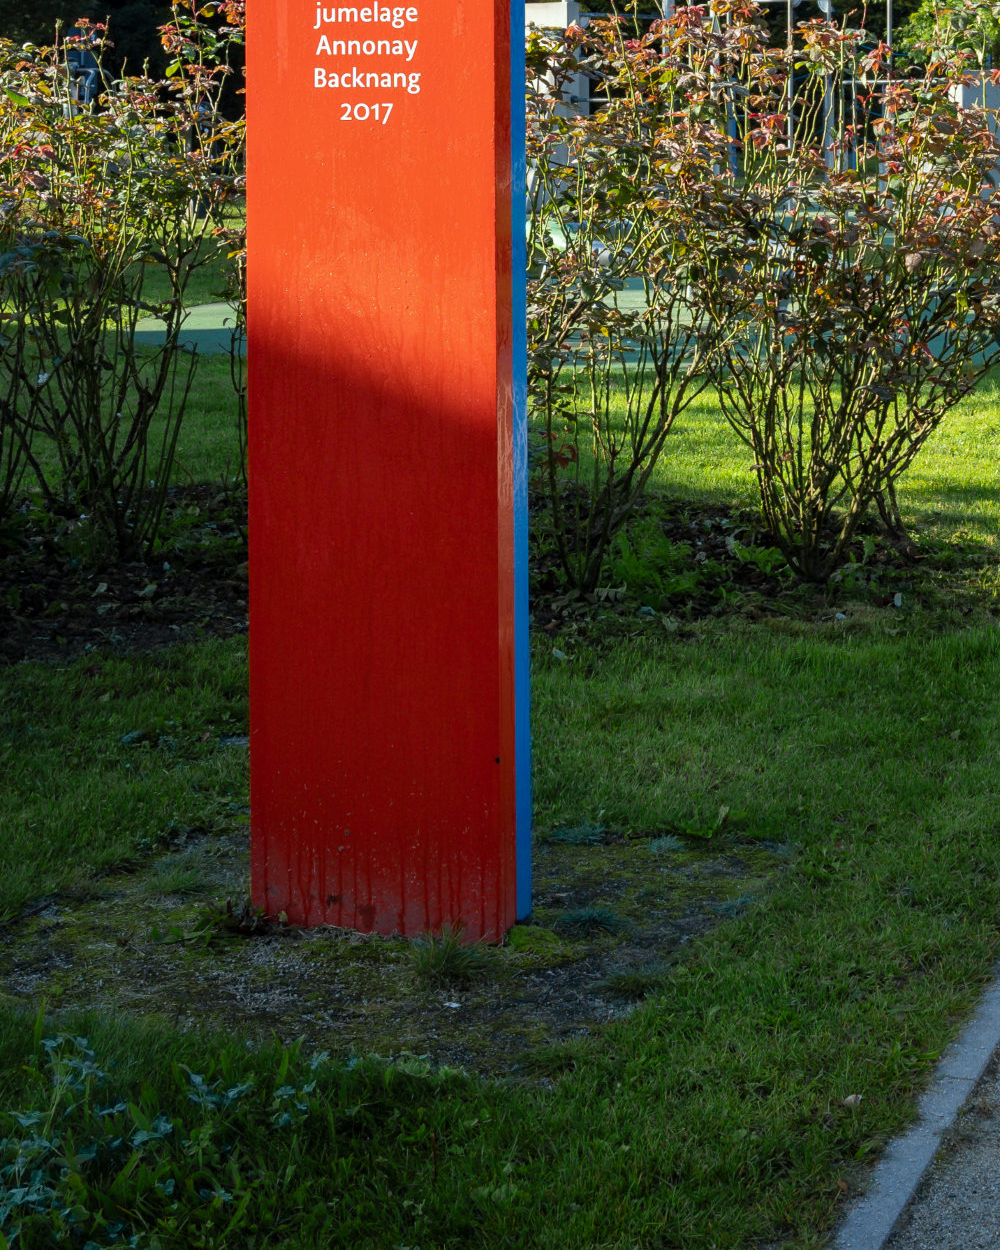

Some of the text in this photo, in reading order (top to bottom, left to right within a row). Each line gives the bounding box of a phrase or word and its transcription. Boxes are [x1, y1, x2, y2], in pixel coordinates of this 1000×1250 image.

[313, 1, 419, 30] jumelage
[315, 34, 419, 62] Annonay
[313, 66, 422, 95] Backnang
[339, 102, 394, 125] 2017
